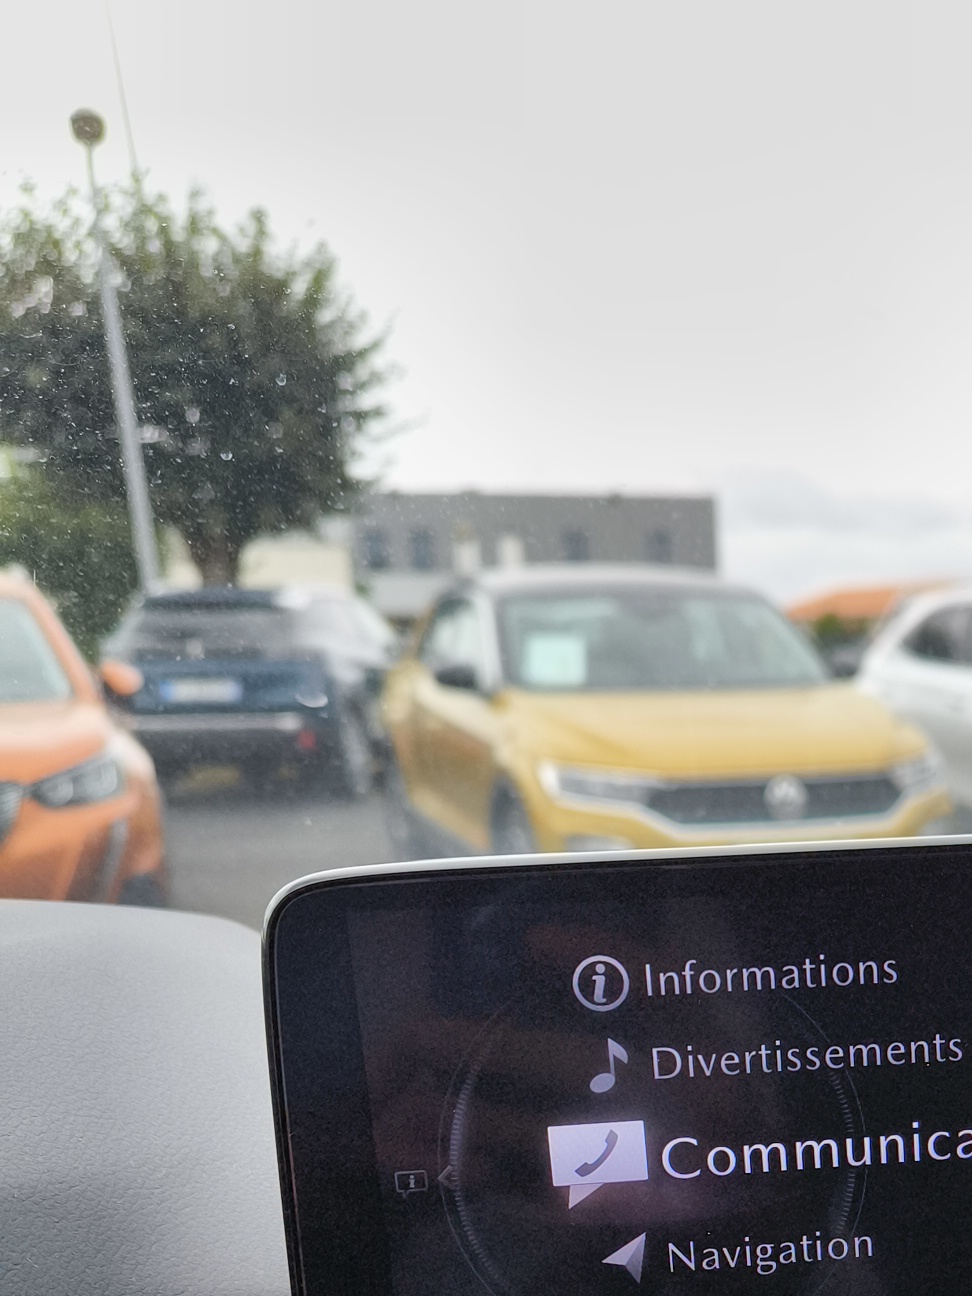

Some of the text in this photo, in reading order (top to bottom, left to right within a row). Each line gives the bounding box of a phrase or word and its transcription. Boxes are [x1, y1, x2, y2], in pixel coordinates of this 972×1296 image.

[645, 954, 898, 997] Informations
[652, 1033, 964, 1080] Divertissements
[668, 1231, 874, 1276] Navigation
